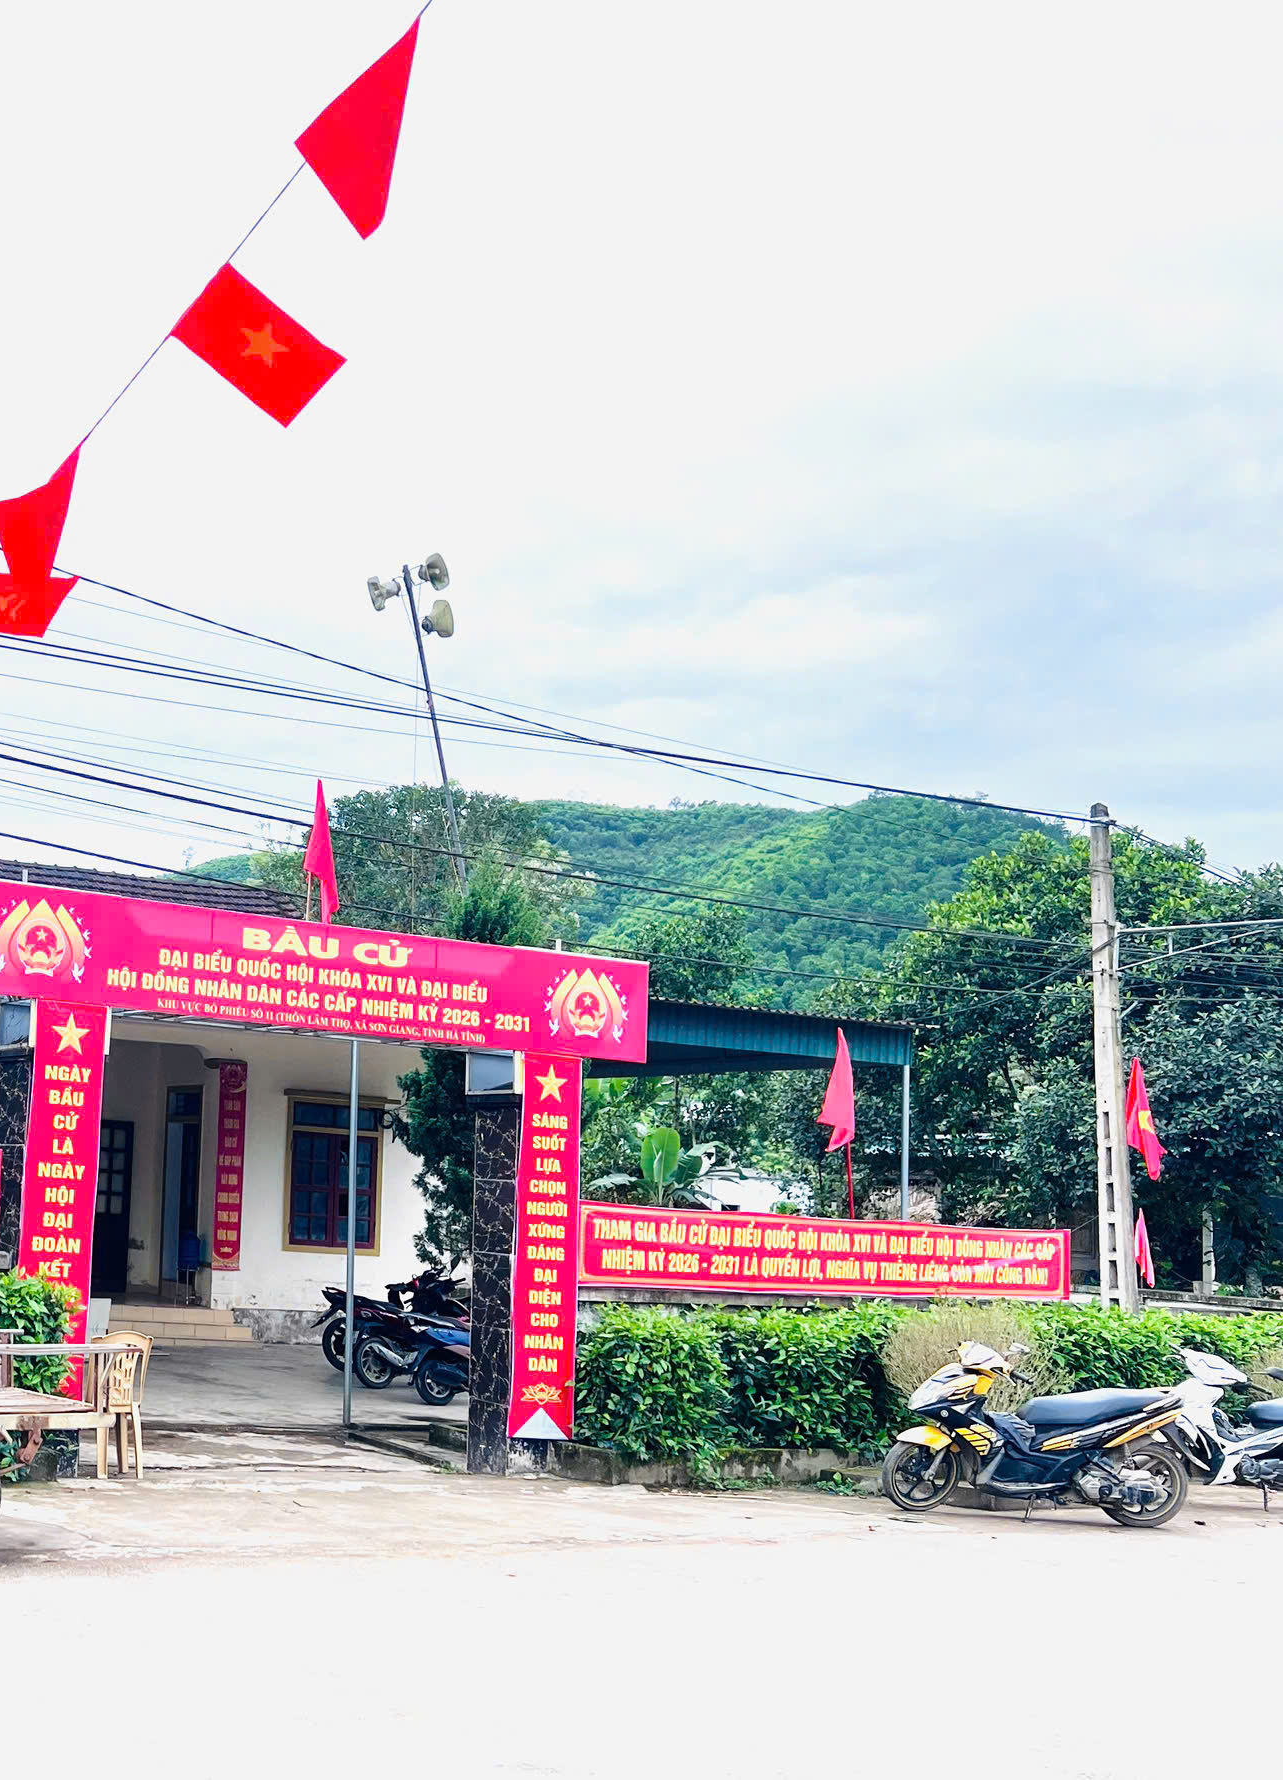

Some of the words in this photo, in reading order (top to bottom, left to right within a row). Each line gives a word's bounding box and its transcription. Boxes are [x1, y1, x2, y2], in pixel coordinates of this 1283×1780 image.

[242, 925, 340, 959] BẦU
[353, 939, 413, 968] CỬ
[159, 949, 188, 970] ĐẠI
[193, 950, 232, 973] BIỂU
[236, 956, 281, 979] QUỐC
[286, 963, 314, 985] HỘI
[318, 967, 362, 989] KHÓA
[367, 974, 392, 993] XVI
[397, 976, 417, 995] VÀ
[421, 980, 447, 1001] ĐẠI
[452, 980, 488, 1003] BIỂU
[107, 966, 137, 990] HỘI
[141, 969, 189, 994] ĐỒNG
[194, 978, 242, 1000] NHÂN
[247, 984, 282, 1005] DÂN
[286, 985, 319, 1008] CÁC
[324, 990, 357, 1012] CẤP
[361, 999, 414, 1022] NHIỆM
[418, 1003, 438, 1023] KỲ
[442, 1007, 480, 1026] 2026
[494, 1014, 530, 1032] 2031
[157, 997, 179, 1010] KHU
[181, 1001, 202, 1013] VỰC
[275, 1010, 305, 1025] (THÔN
[307, 1015, 328, 1027] LÂM
[355, 1018, 367, 1031] XÃ
[369, 1021, 388, 1033] SƠN
[446, 1027, 459, 1041] HÀ
[45, 1064, 92, 1083] NGÀY
[49, 1086, 84, 1107] BẦU
[53, 1111, 79, 1130] CỬ
[532, 1112, 568, 1129] SÁNG
[53, 1136, 73, 1155] LÀ
[532, 1133, 566, 1151] SUỐT
[37, 1161, 85, 1180] NGÀY
[536, 1157, 561, 1175] LỰA
[45, 1185, 75, 1206] HỘI
[529, 1179, 566, 1197] CHỌN
[526, 1200, 568, 1217] NGƯỜI
[43, 1211, 73, 1231] ĐẠI
[528, 1221, 565, 1239] XỨNG
[31, 1234, 81, 1254] ĐOÀN
[593, 1218, 631, 1240] THAM
[634, 1222, 657, 1242] GIA
[689, 1219, 708, 1245] CỬ
[709, 1226, 731, 1250] ĐẠI
[733, 1221, 761, 1248] BIỂU
[764, 1224, 795, 1250] QUỐC
[798, 1228, 818, 1254] HỘI
[821, 1229, 850, 1252] KHÓA
[852, 1234, 870, 1253] XVI
[873, 1232, 887, 1254] VÀ
[889, 1236, 907, 1258] ĐẠI
[910, 1231, 933, 1256] BIỂU
[936, 1235, 953, 1260] HỘI
[985, 1238, 1012, 1259] NHÂN
[1014, 1239, 1034, 1260] CÁC
[527, 1243, 565, 1261] ĐÁNG
[38, 1257, 72, 1278] KẾT
[602, 1246, 645, 1275] NHIỆM
[649, 1247, 665, 1272] KỲ
[669, 1253, 699, 1273] 2026
[710, 1254, 739, 1275] 2031
[743, 1253, 758, 1276] LÀ
[826, 1257, 860, 1279] NGHĨA
[863, 1261, 877, 1284] VỤ
[534, 1267, 557, 1285] ĐẠI
[528, 1288, 561, 1307] DIỆN
[530, 1312, 559, 1327] CHO
[524, 1333, 563, 1350] NHÂN
[528, 1355, 557, 1372] DÂN
